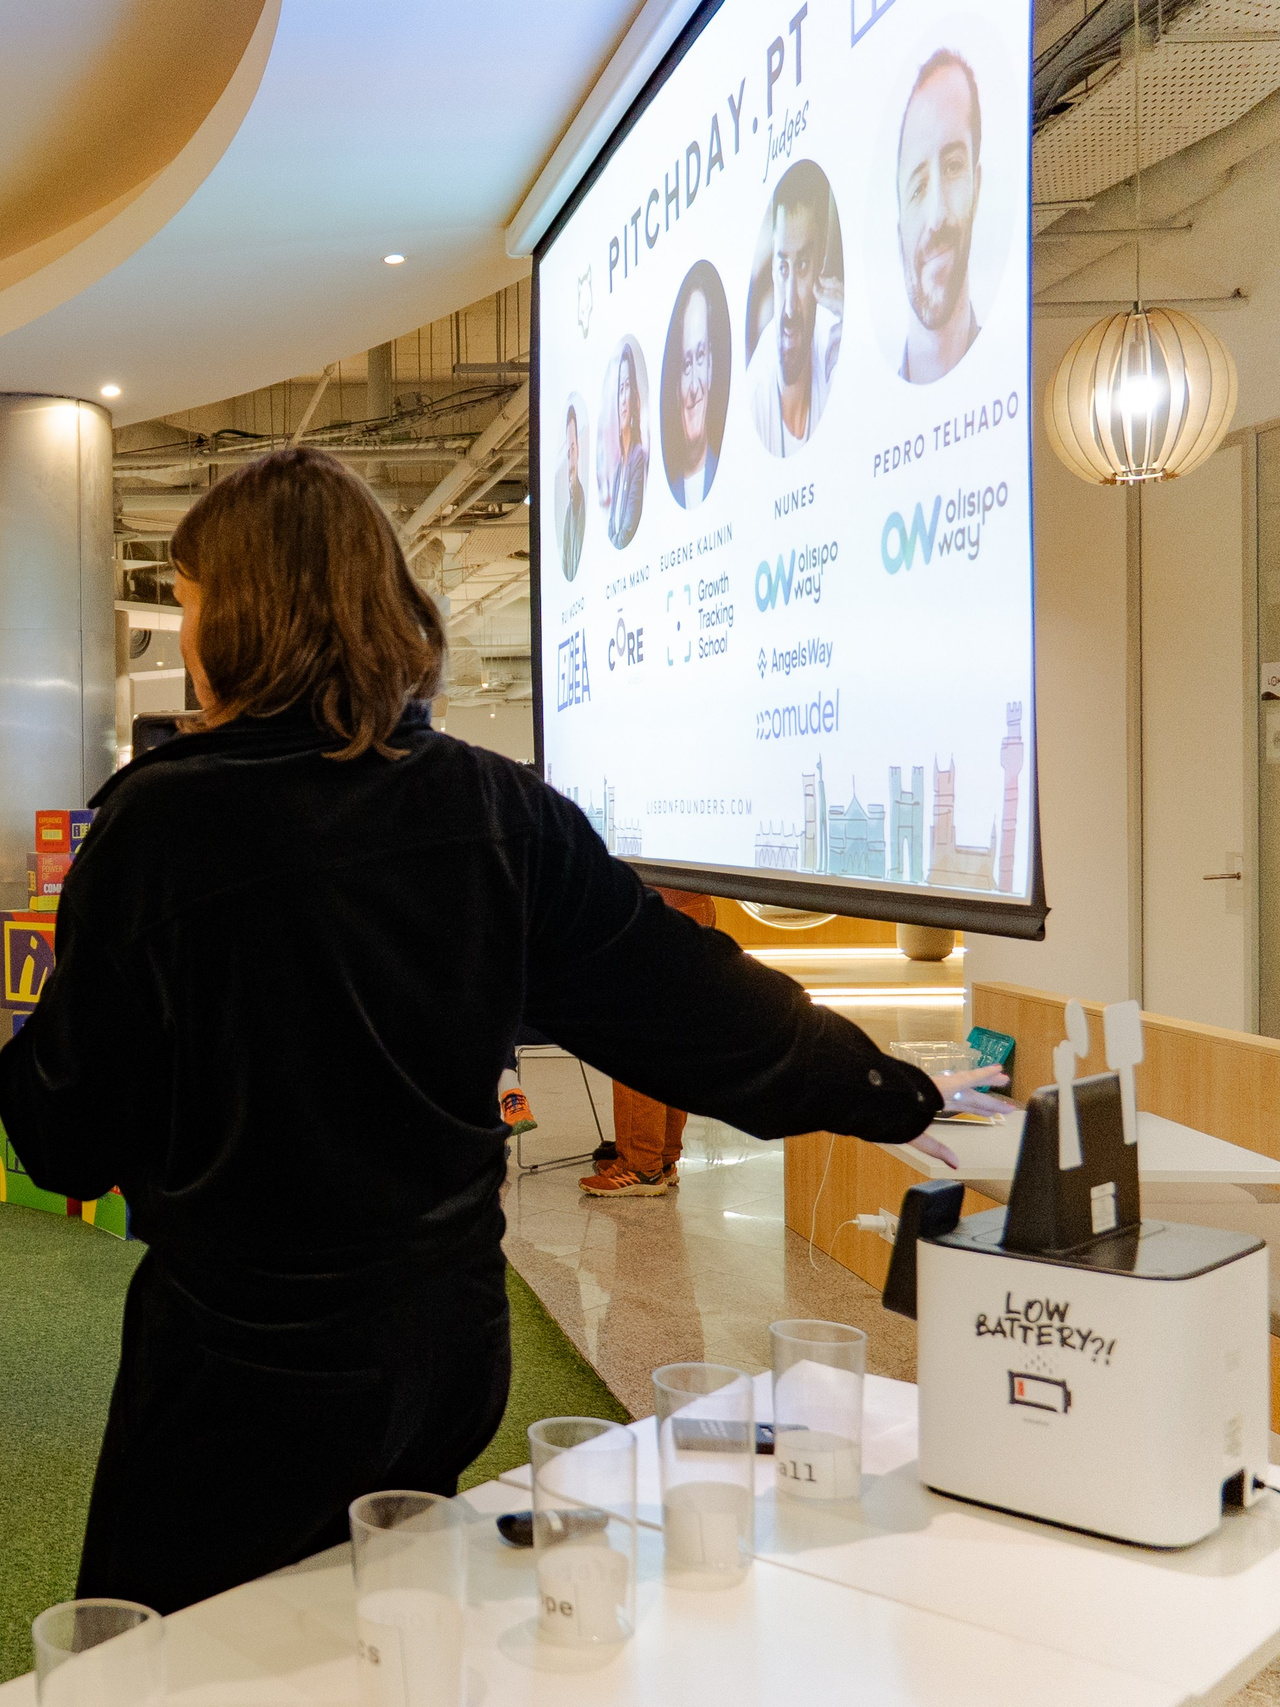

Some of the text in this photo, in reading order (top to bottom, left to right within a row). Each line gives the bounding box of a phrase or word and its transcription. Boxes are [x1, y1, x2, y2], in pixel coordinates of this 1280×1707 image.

[608, 2, 808, 294] PITCHDAY.PT
[873, 391, 1019, 478] PEDRO TELHADO
[774, 482, 815, 520] NUNES
[945, 481, 1009, 526] olisipo
[660, 521, 733, 572] EUGENE KALININ
[798, 540, 839, 576] olisipo
[938, 522, 981, 561] way
[629, 564, 651, 589] MANO
[697, 570, 730, 602] Growth
[794, 572, 821, 604] way
[697, 601, 734, 629] Tracking
[697, 629, 729, 659] School
[771, 637, 833, 676] AngelsWay
[646, 798, 753, 816] LISBONFOUNDERS.COM
[1006, 1292, 1071, 1324] LOW
[976, 1313, 1117, 1366] BATTERY?!
